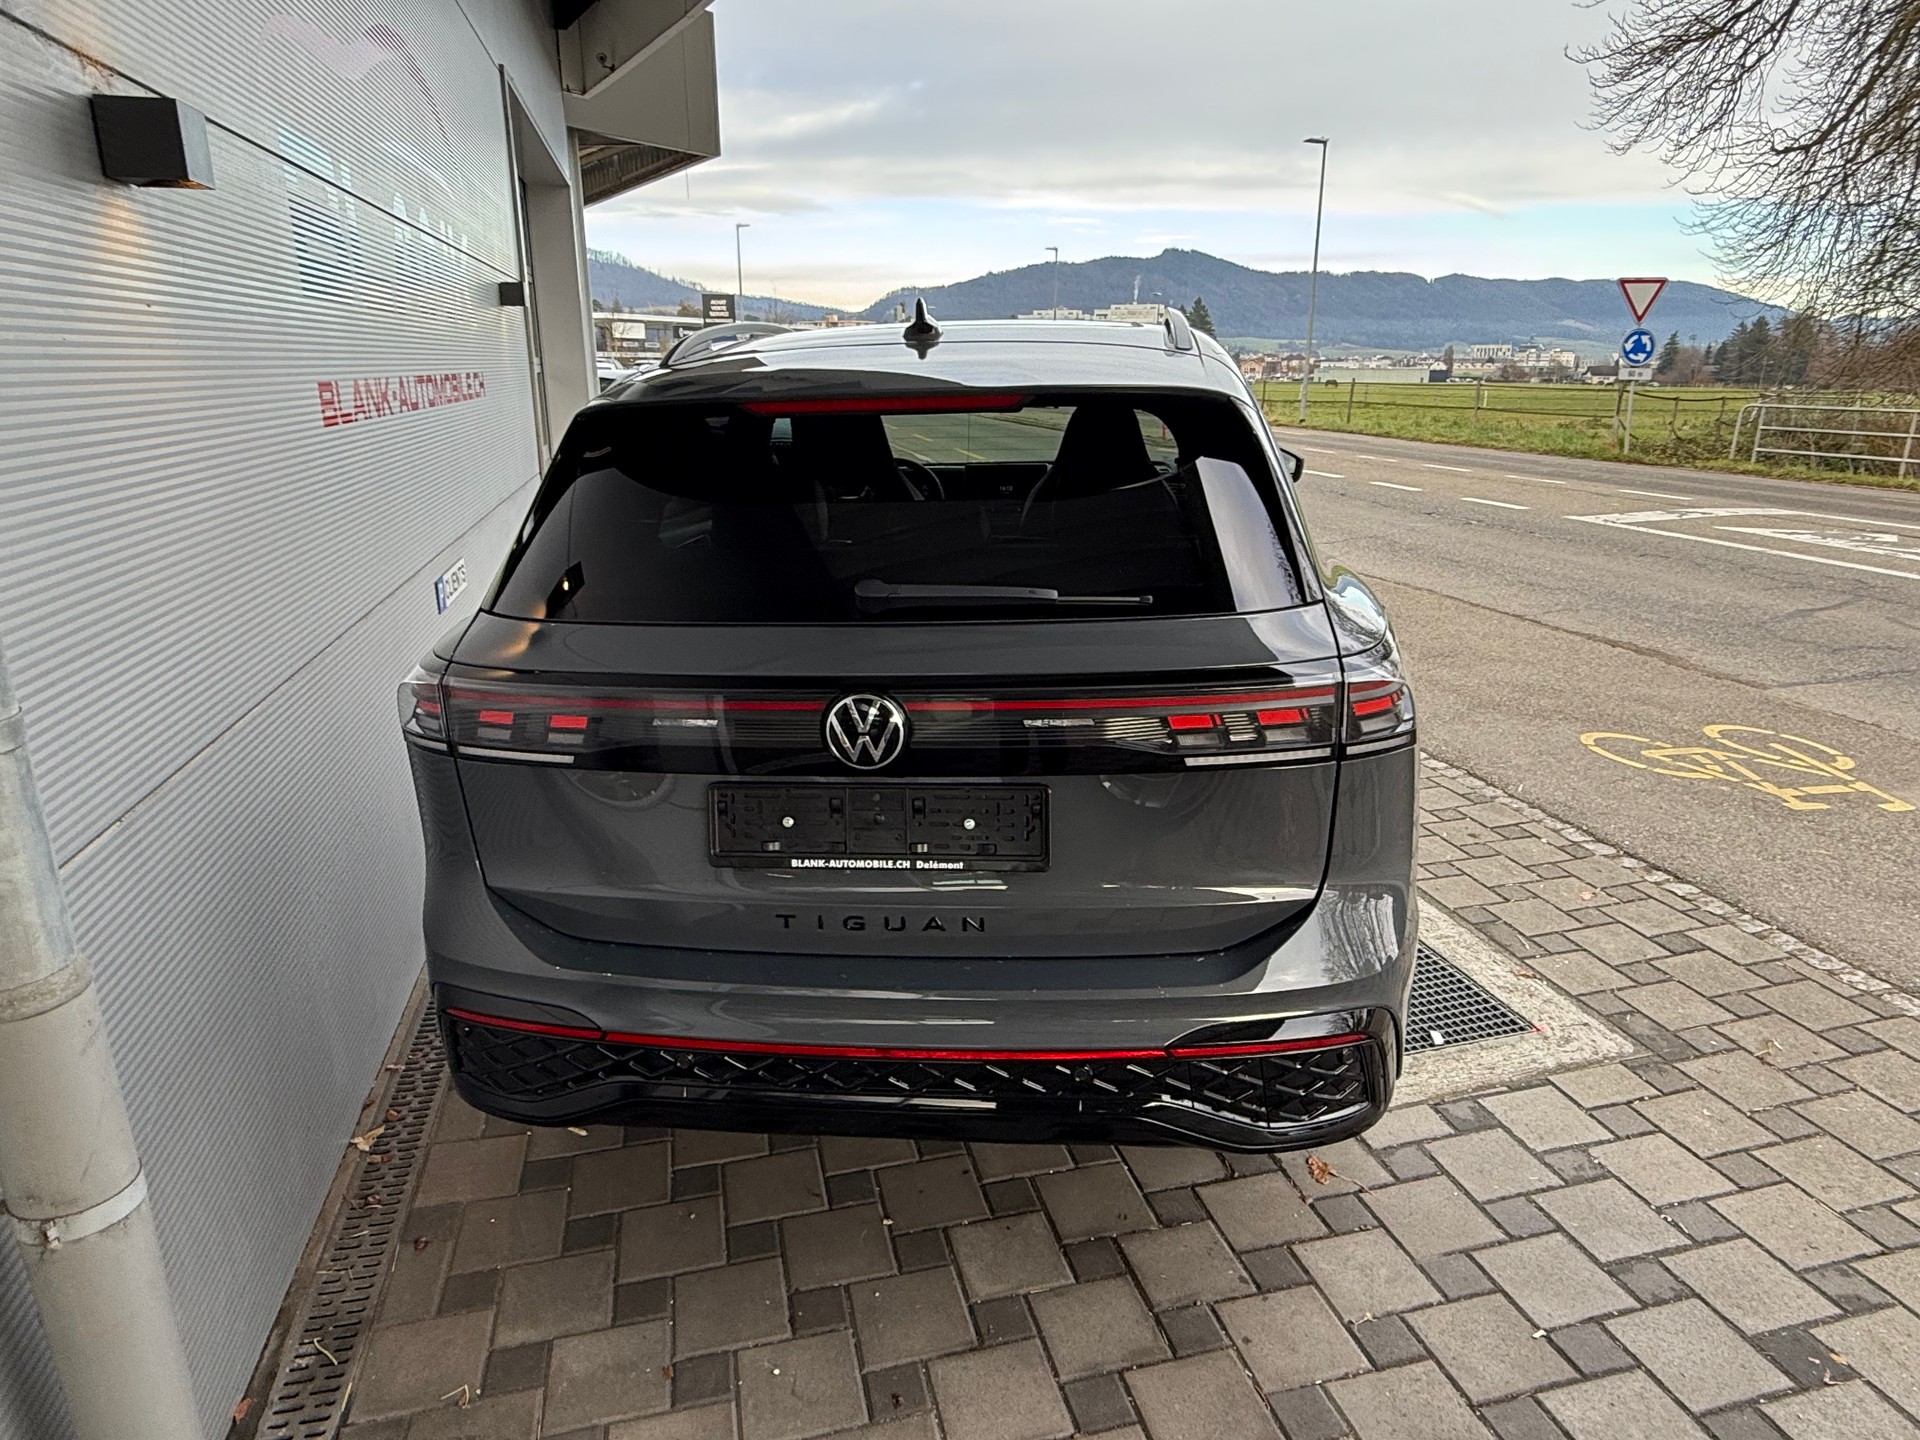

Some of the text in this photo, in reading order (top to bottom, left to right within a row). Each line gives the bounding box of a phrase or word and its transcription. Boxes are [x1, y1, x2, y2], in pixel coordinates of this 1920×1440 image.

[828, 696, 902, 766] VW
[791, 858, 964, 870] BLANK-AUTOMOBILE.CH Delémont
[775, 913, 985, 932] TIGUAN
